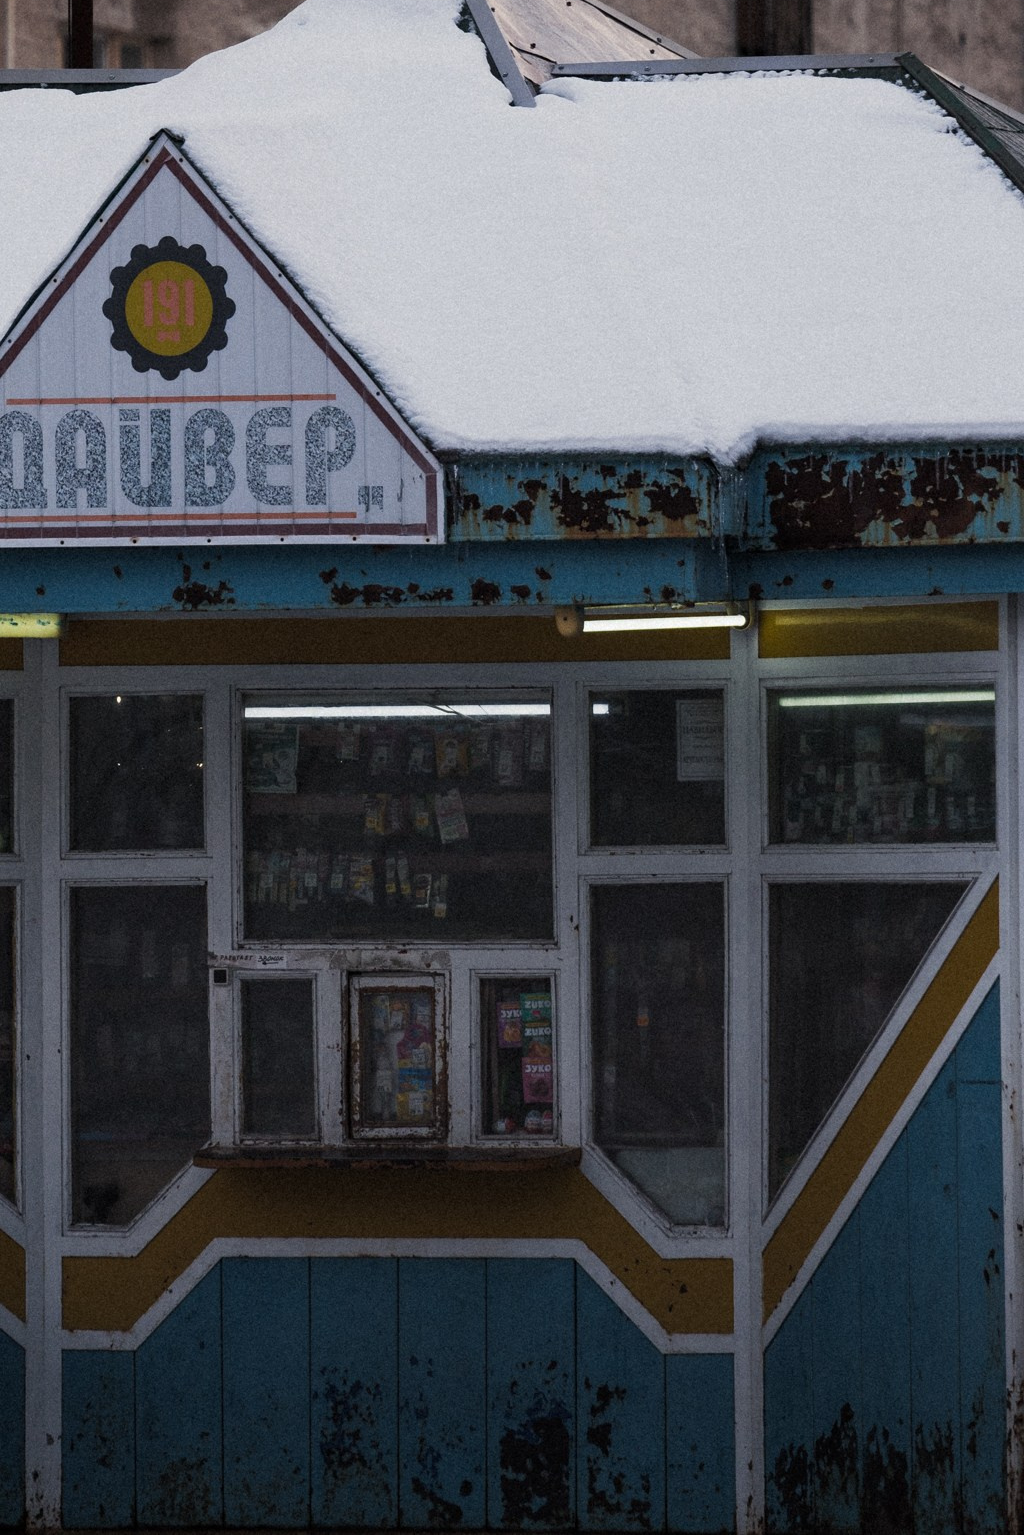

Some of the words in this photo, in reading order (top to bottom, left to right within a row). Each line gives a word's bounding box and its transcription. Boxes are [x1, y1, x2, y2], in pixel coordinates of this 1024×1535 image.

[143, 278, 195, 327] 191
[525, 1000, 551, 1009] ZUKO
[524, 1027, 551, 1036] ZUKO
[525, 1064, 551, 1073] ЗУКО
